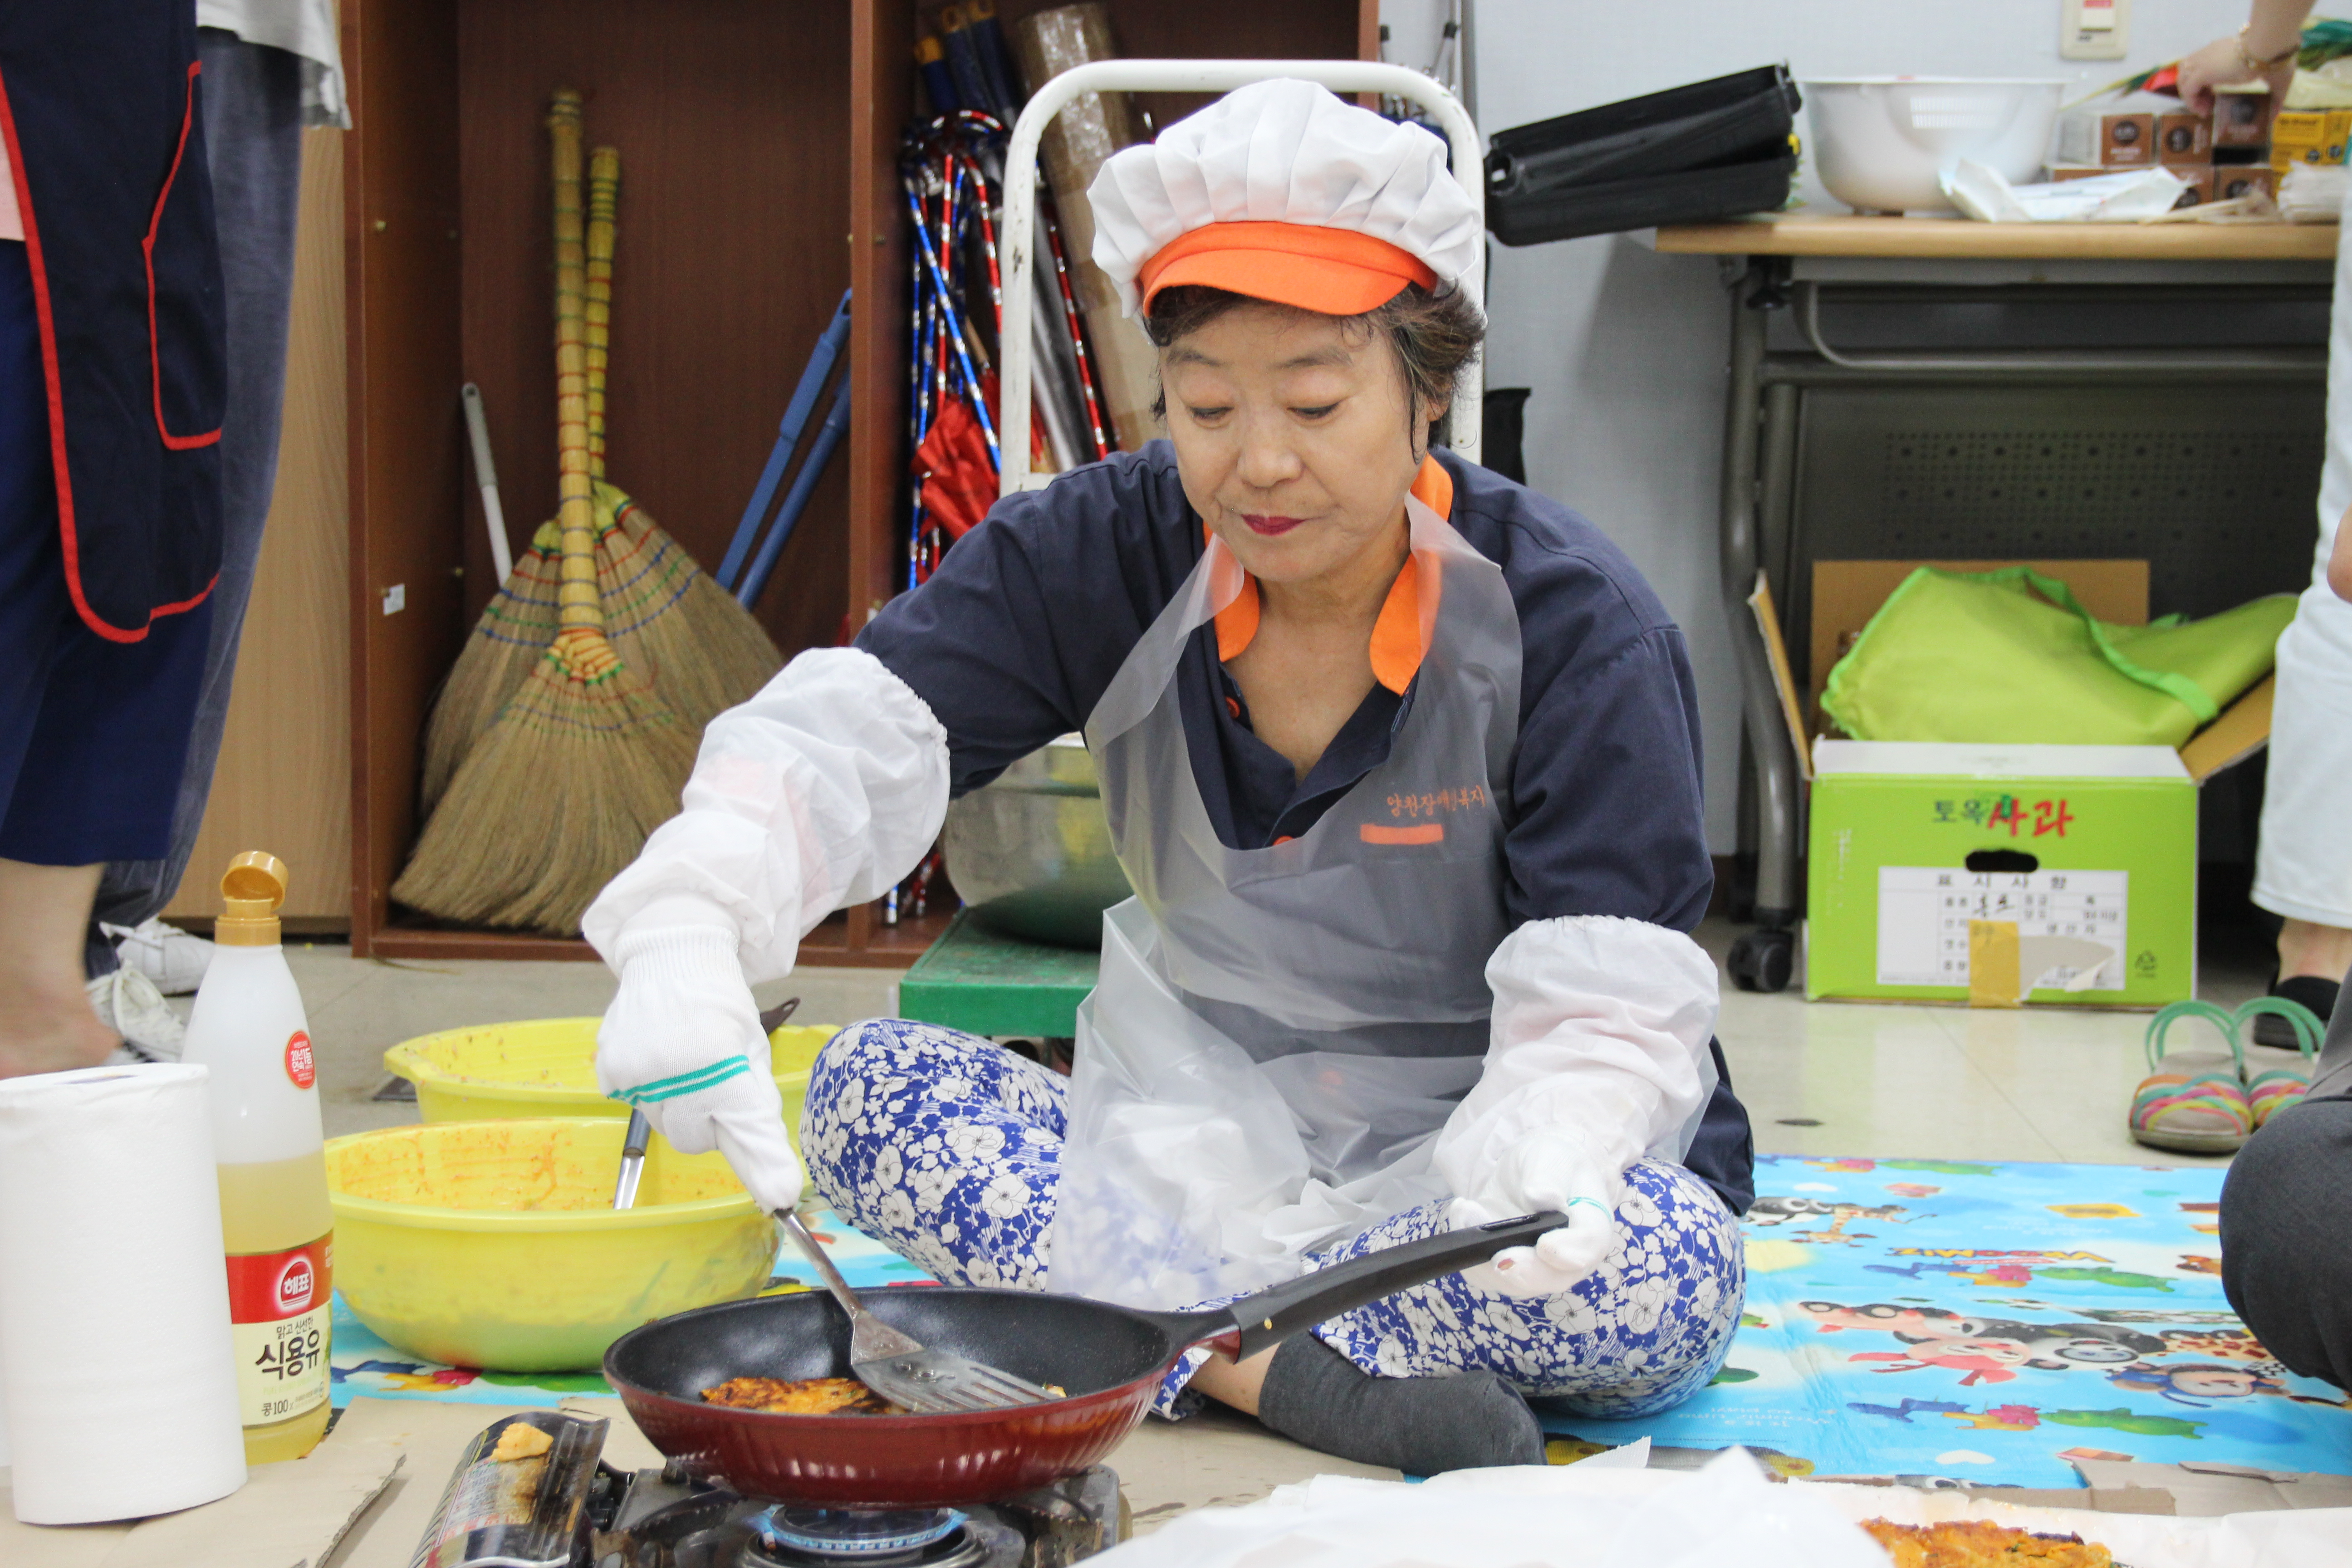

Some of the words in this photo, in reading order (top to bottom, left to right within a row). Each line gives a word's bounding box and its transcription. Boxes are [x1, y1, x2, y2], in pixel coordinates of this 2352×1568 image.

[1987, 797, 2074, 838] 사과
[284, 1272, 309, 1295] 해표
[277, 1323, 293, 1339] 맑고
[295, 1315, 314, 1335] 신선한
[255, 1329, 320, 1380] 식용유
